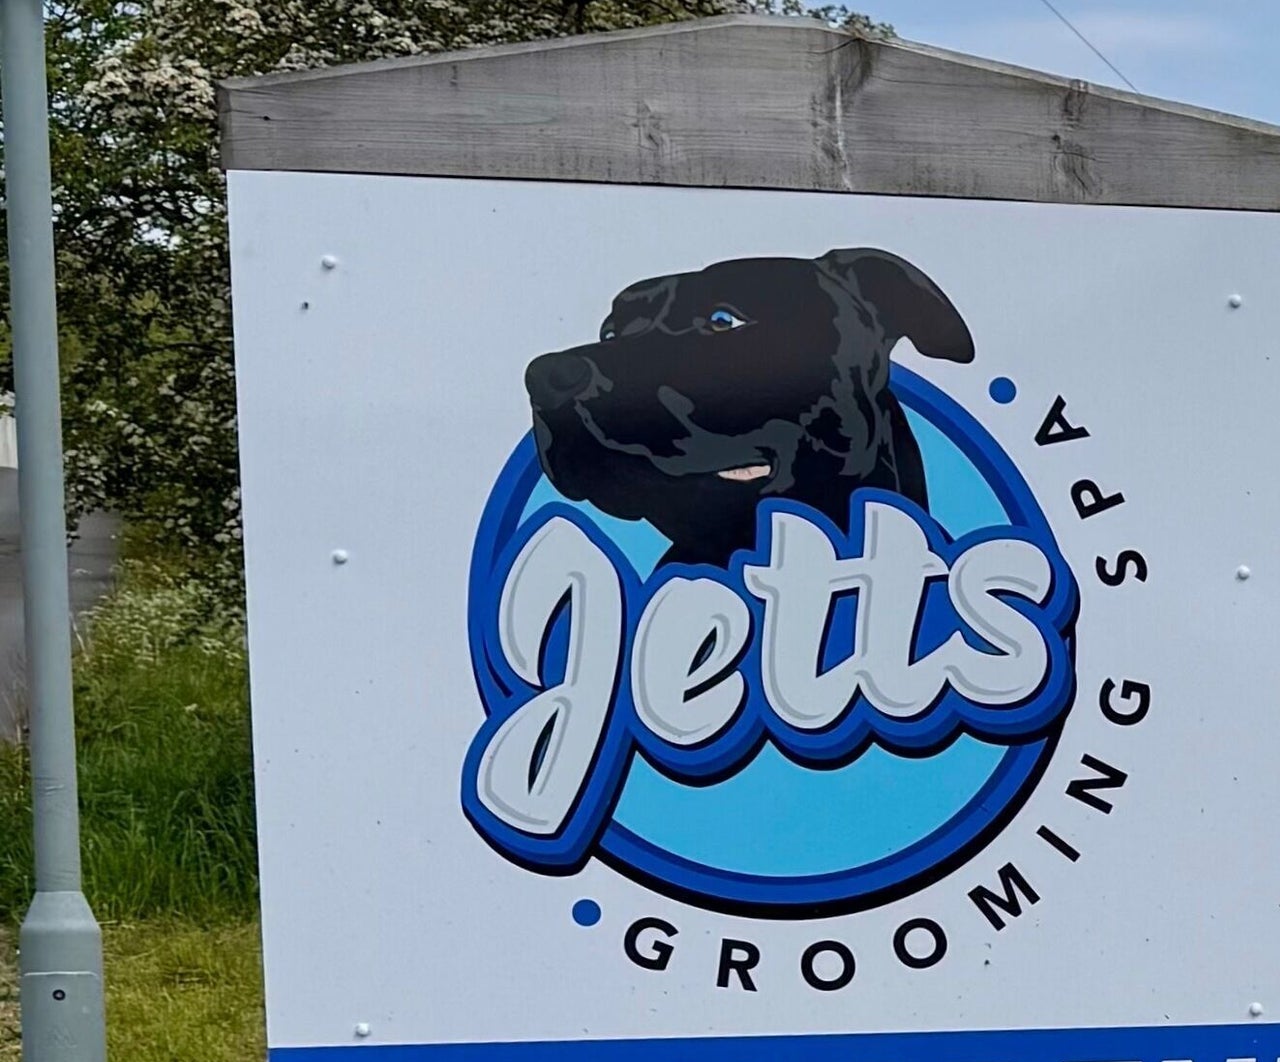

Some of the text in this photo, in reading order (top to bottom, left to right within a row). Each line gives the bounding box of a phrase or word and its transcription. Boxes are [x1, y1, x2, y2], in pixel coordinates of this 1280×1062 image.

[475, 499, 1054, 835] Jetts
[623, 395, 1151, 992] GROOMING SPA
